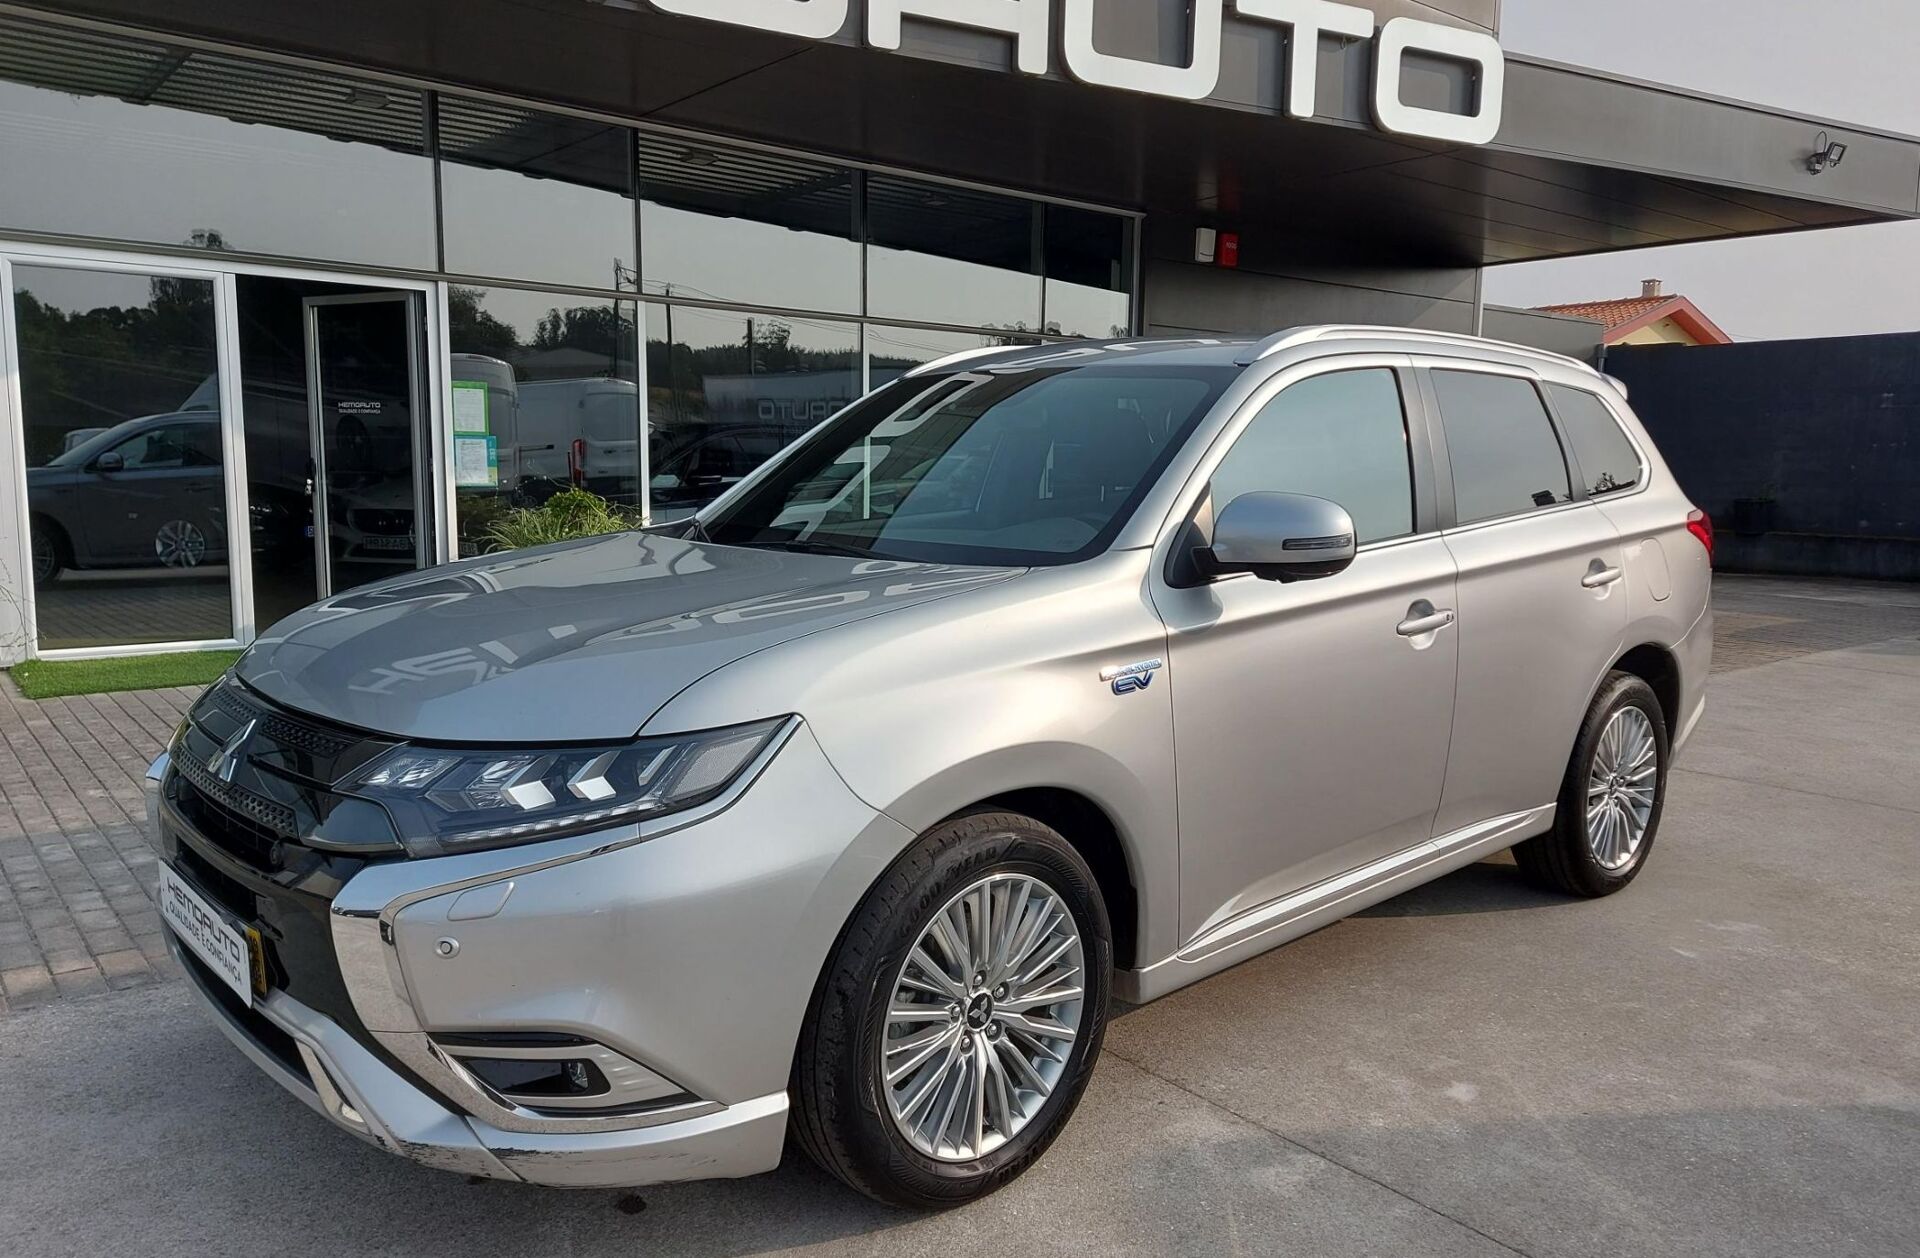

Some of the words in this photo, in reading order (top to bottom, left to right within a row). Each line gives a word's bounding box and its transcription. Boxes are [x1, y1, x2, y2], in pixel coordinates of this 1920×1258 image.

[648, 0, 1504, 145] UTO
[1111, 670, 1154, 696] EV
[167, 876, 241, 964] HEMOAUTO
